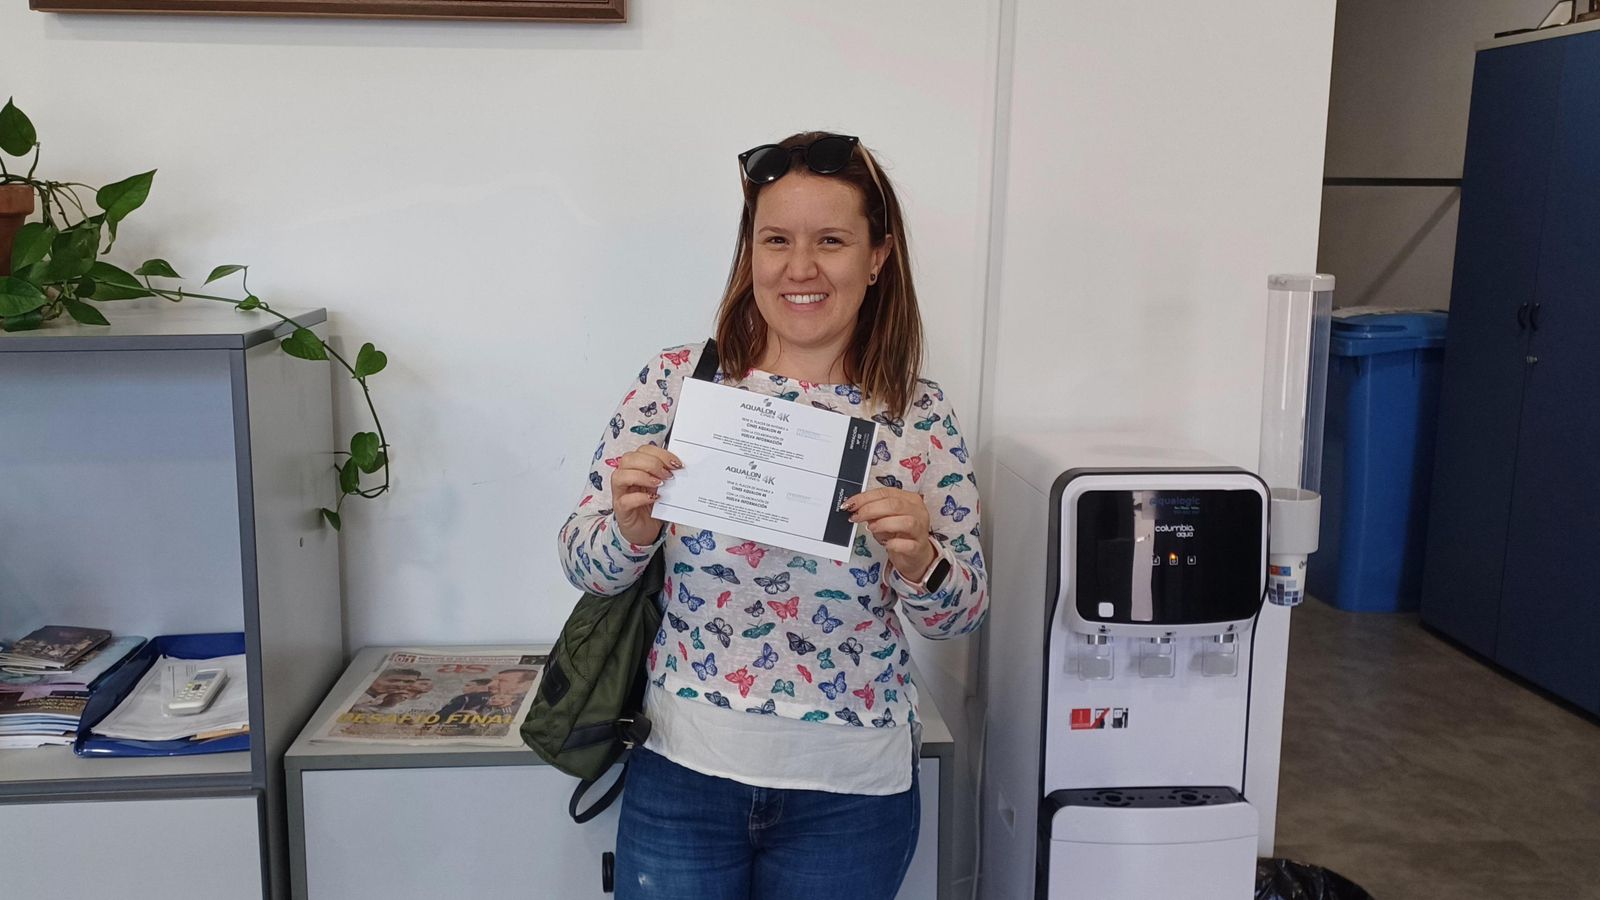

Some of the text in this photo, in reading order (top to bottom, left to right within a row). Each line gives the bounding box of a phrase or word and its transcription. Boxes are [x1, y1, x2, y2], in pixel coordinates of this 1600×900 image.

[739, 402, 790, 422] AQUALON 4K
[758, 425, 776, 433] AQUALON
[755, 435, 782, 445] INFORMACIÓN
[725, 465, 775, 485] AQUALON 4K
[743, 488, 761, 496] AQUALON
[740, 498, 767, 508] INFORMACIÓN
[1155, 524, 1195, 532] columbia
[437, 664, 490, 673] as
[445, 713, 514, 726] FINAL
